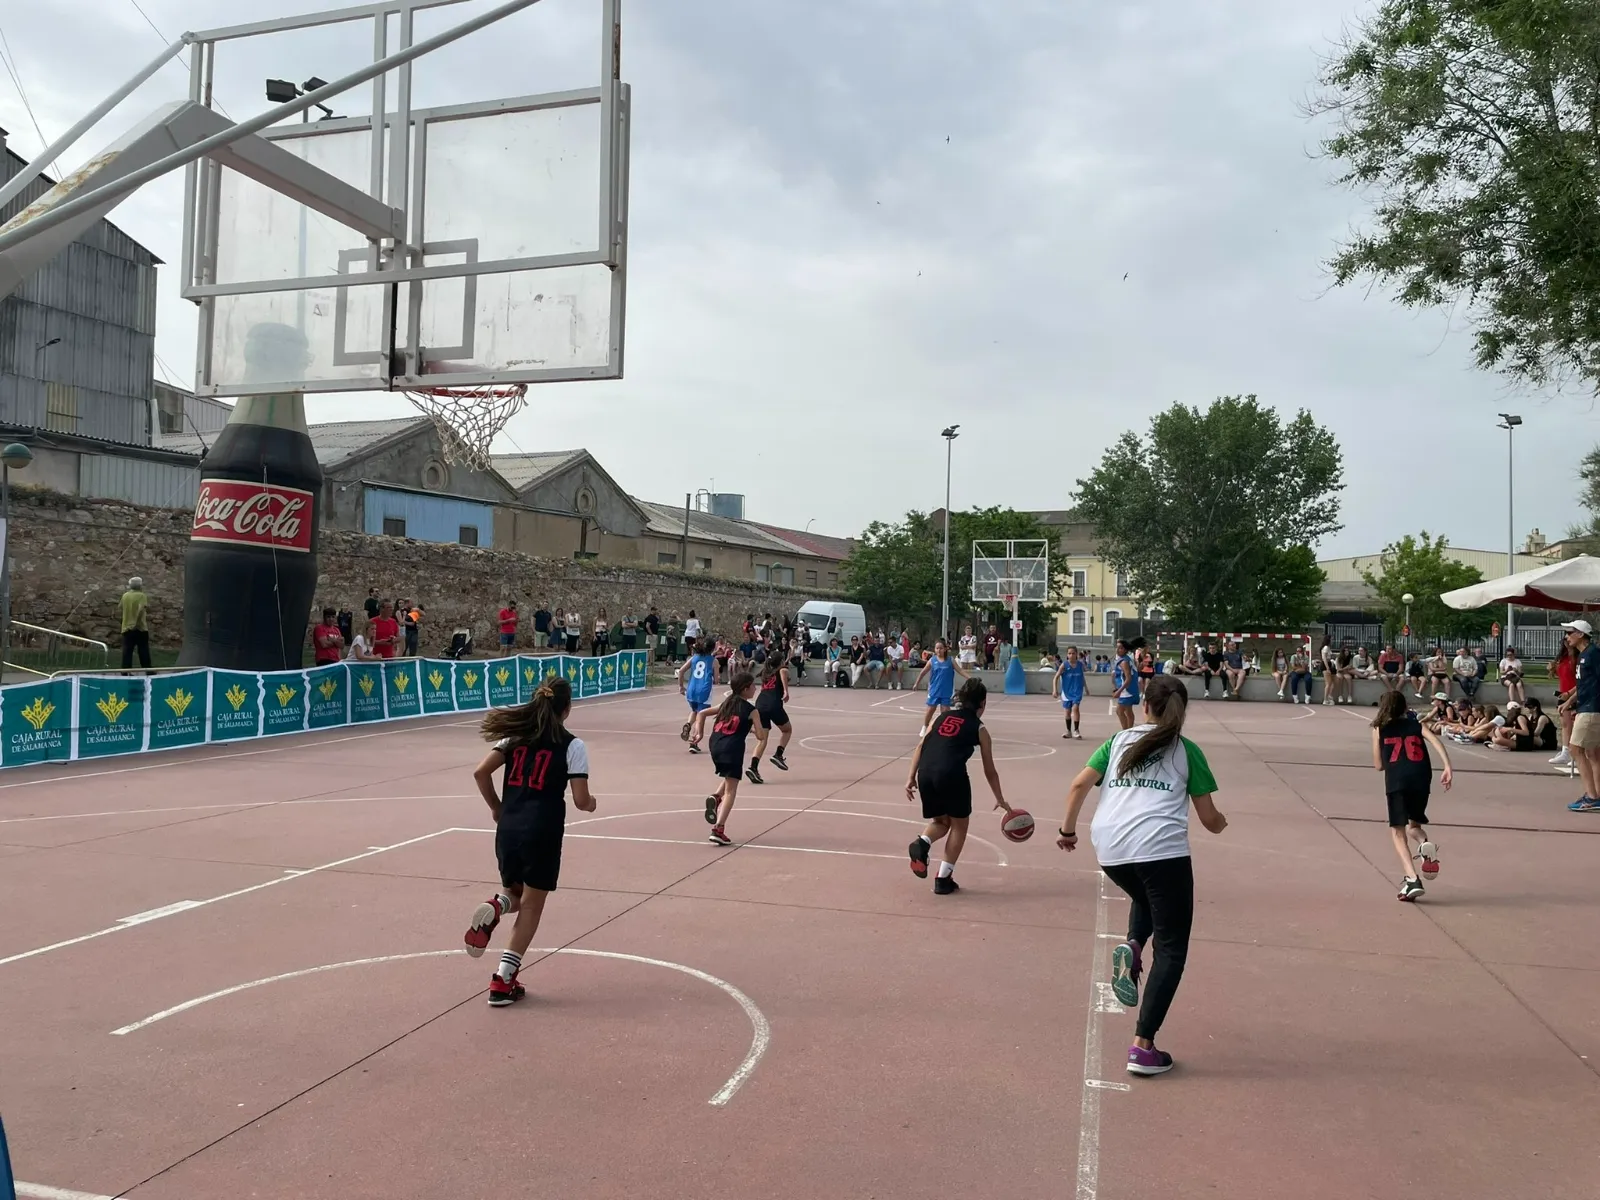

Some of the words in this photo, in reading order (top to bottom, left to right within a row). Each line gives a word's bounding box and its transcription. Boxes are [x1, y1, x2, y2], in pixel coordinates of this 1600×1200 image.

[193, 486, 307, 540] Coca-Cola
[693, 661, 706, 679] 8
[157, 720, 176, 730] CAJA
[176, 716, 200, 726] RURAL
[217, 713, 233, 722] CAJA
[233, 711, 254, 720] RURAL
[86, 726, 108, 736] CAJA
[108, 723, 136, 734] RURAL
[165, 725, 200, 736] SALAMANCA
[938, 715, 965, 737] 5
[11, 732, 34, 744] CAJA
[35, 729, 63, 741] RURAL
[86, 736, 95, 744] DE
[95, 733, 136, 743] SALAMANCA
[11, 745, 22, 753] DE
[22, 739, 62, 752] SALAMANCA
[1383, 735, 1425, 763] 76
[1134, 777, 1174, 792] RURAL
